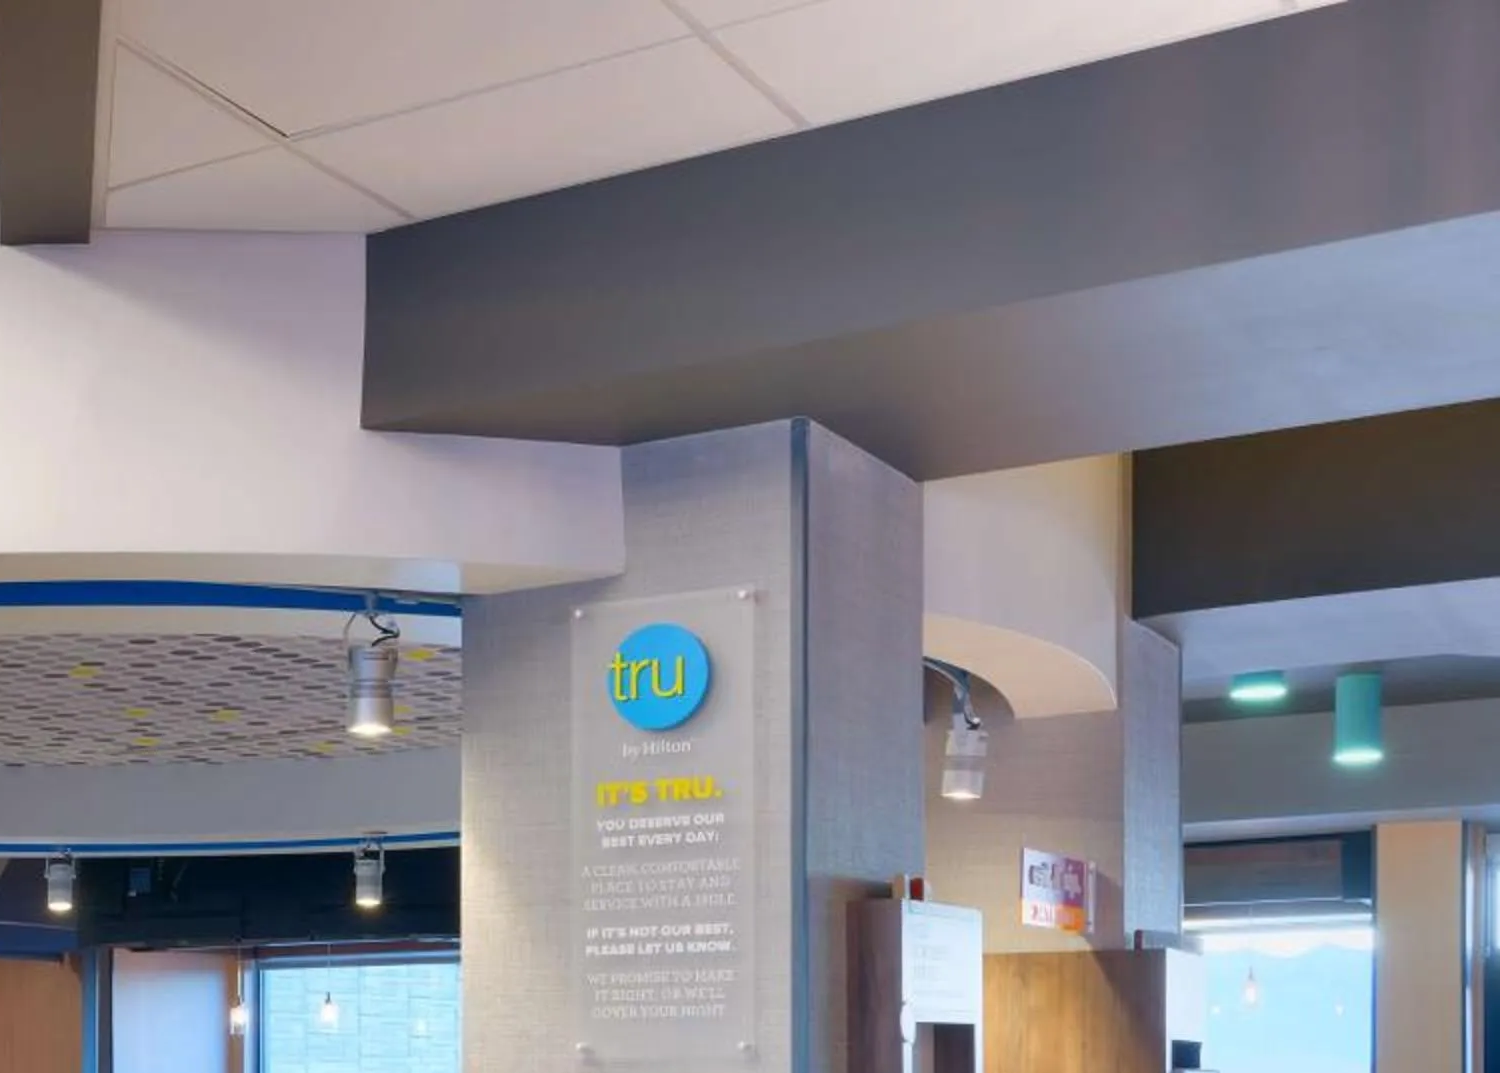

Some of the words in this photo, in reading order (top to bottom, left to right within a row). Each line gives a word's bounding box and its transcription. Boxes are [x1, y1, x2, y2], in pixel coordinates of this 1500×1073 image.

[607, 652, 685, 702] tru
[622, 742, 640, 761] by
[643, 739, 692, 755] Hilton
[596, 780, 649, 807] IT'S
[655, 775, 724, 801] TRU.
[596, 819, 625, 832] YOU
[628, 815, 691, 830] DESERVE
[693, 813, 725, 826] OUR
[602, 836, 635, 849] BEST
[638, 833, 682, 847] EVERY
[586, 927, 599, 940] IF
[629, 925, 659, 938] NOT
[661, 924, 692, 937] OUR
[586, 943, 635, 957] PLEASE
[637, 942, 663, 955] LET
[665, 941, 684, 954] US
